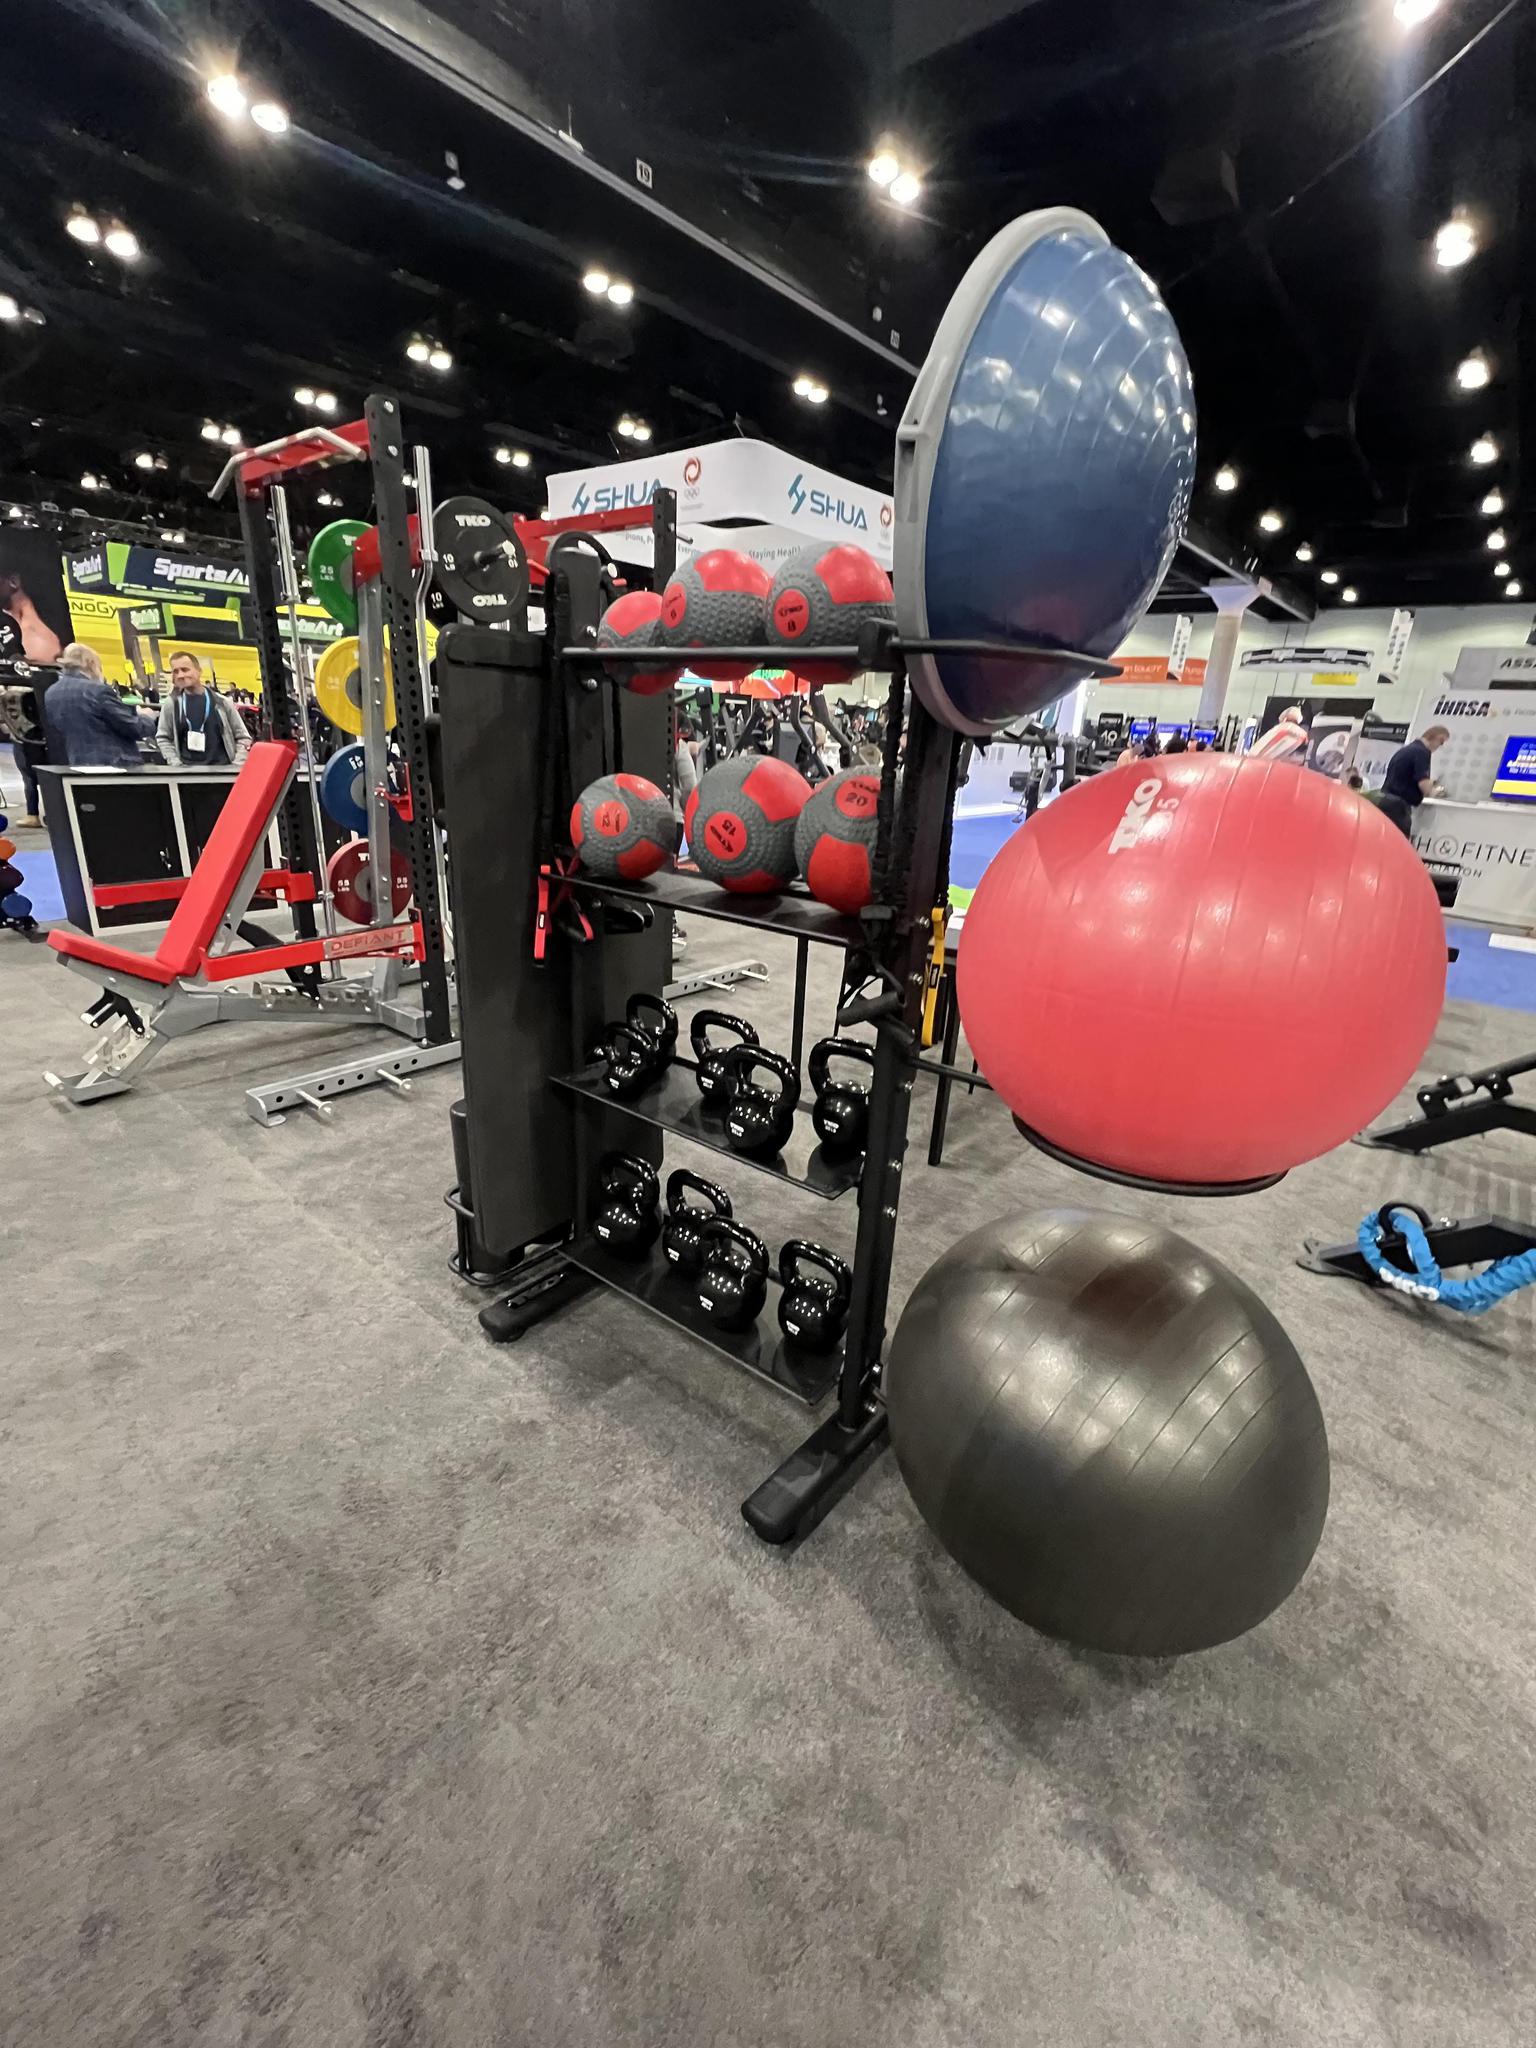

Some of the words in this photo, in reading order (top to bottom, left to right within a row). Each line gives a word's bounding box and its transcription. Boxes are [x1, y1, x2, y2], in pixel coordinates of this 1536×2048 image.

[810, 489, 868, 531] SHUA
[455, 515, 491, 527] TKO
[443, 553, 454, 563] 10
[431, 592, 442, 602] 10
[472, 593, 507, 607] TKO
[1500, 657, 1536, 669] ASS
[1107, 778, 1163, 855] TKO
[331, 929, 405, 951] DEFIANT
